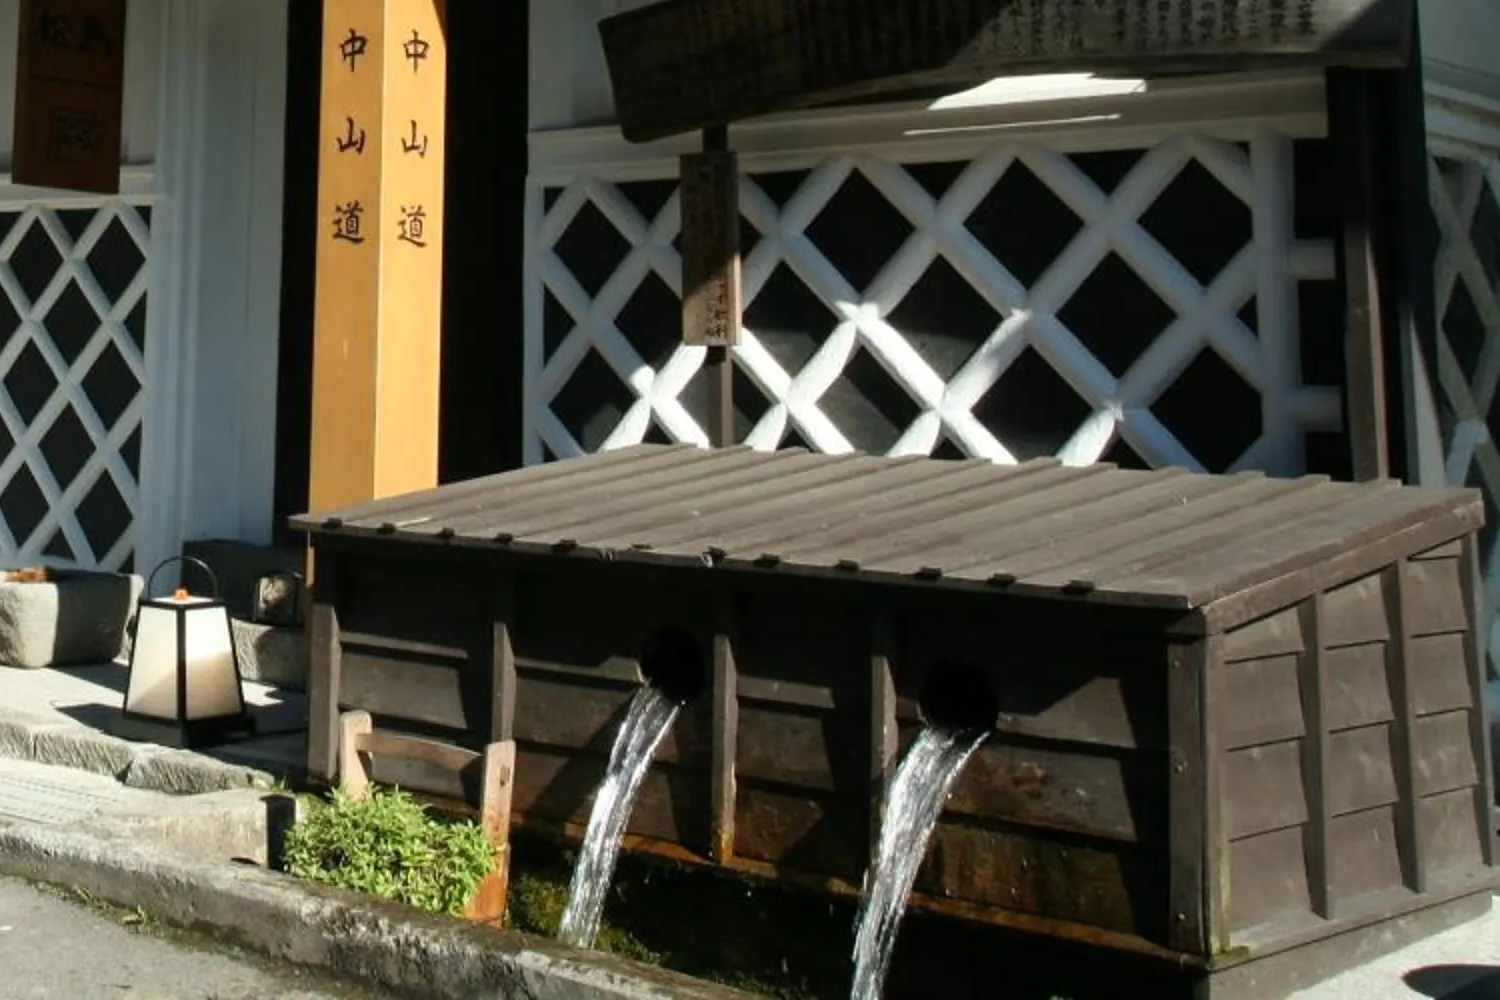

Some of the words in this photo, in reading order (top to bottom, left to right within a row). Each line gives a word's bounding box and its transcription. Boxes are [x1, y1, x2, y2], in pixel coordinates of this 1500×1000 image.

[332, 29, 368, 245] 中山道
[398, 30, 430, 248] 中山道
